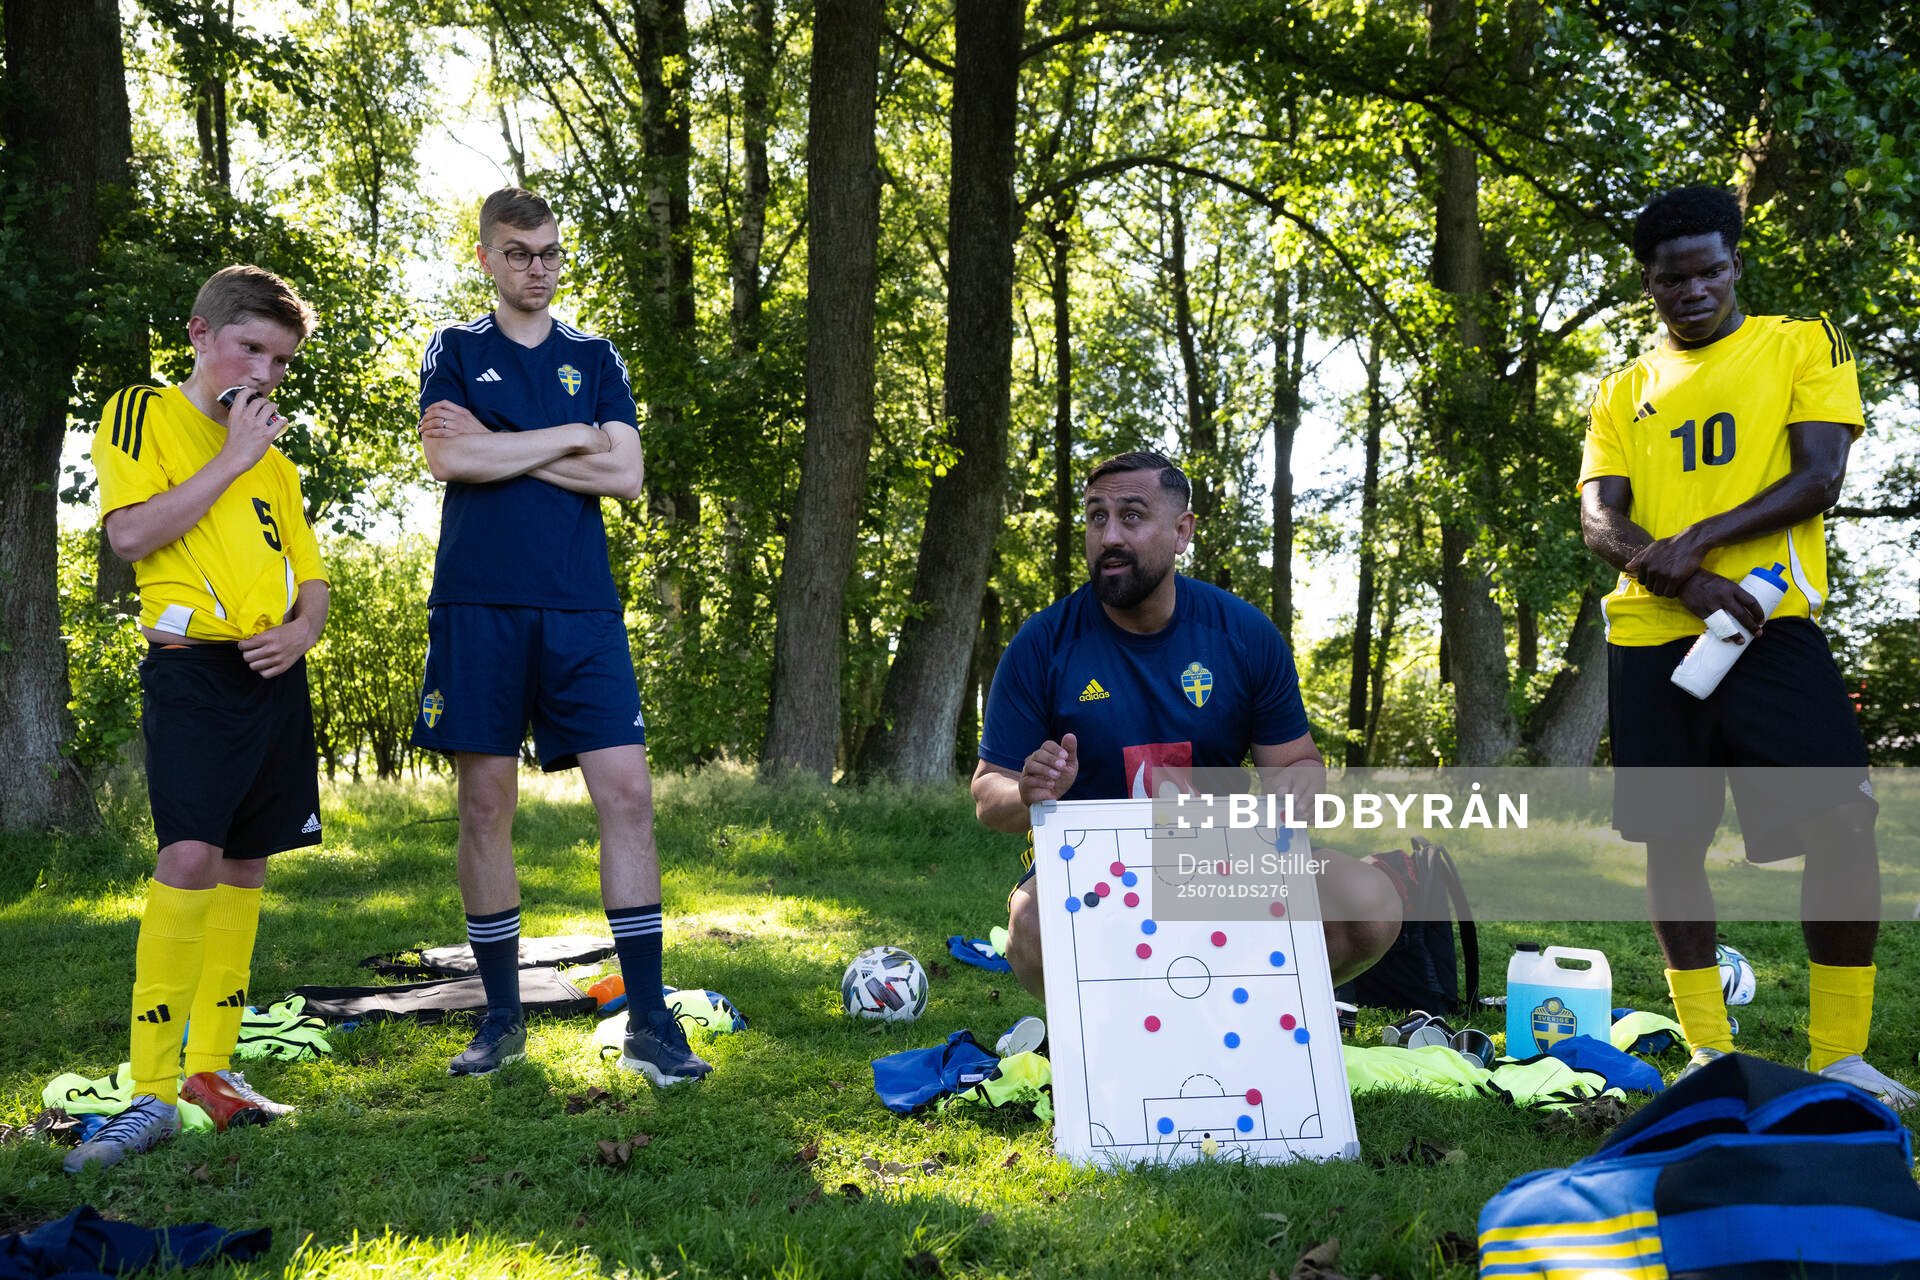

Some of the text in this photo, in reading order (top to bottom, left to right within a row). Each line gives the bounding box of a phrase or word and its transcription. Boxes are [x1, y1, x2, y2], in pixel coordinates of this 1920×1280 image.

[1670, 412, 1736, 472] 10
[251, 497, 282, 552] 5
[1079, 691, 1110, 702] adidas
[1537, 1015, 1569, 1023] SVERIGE
